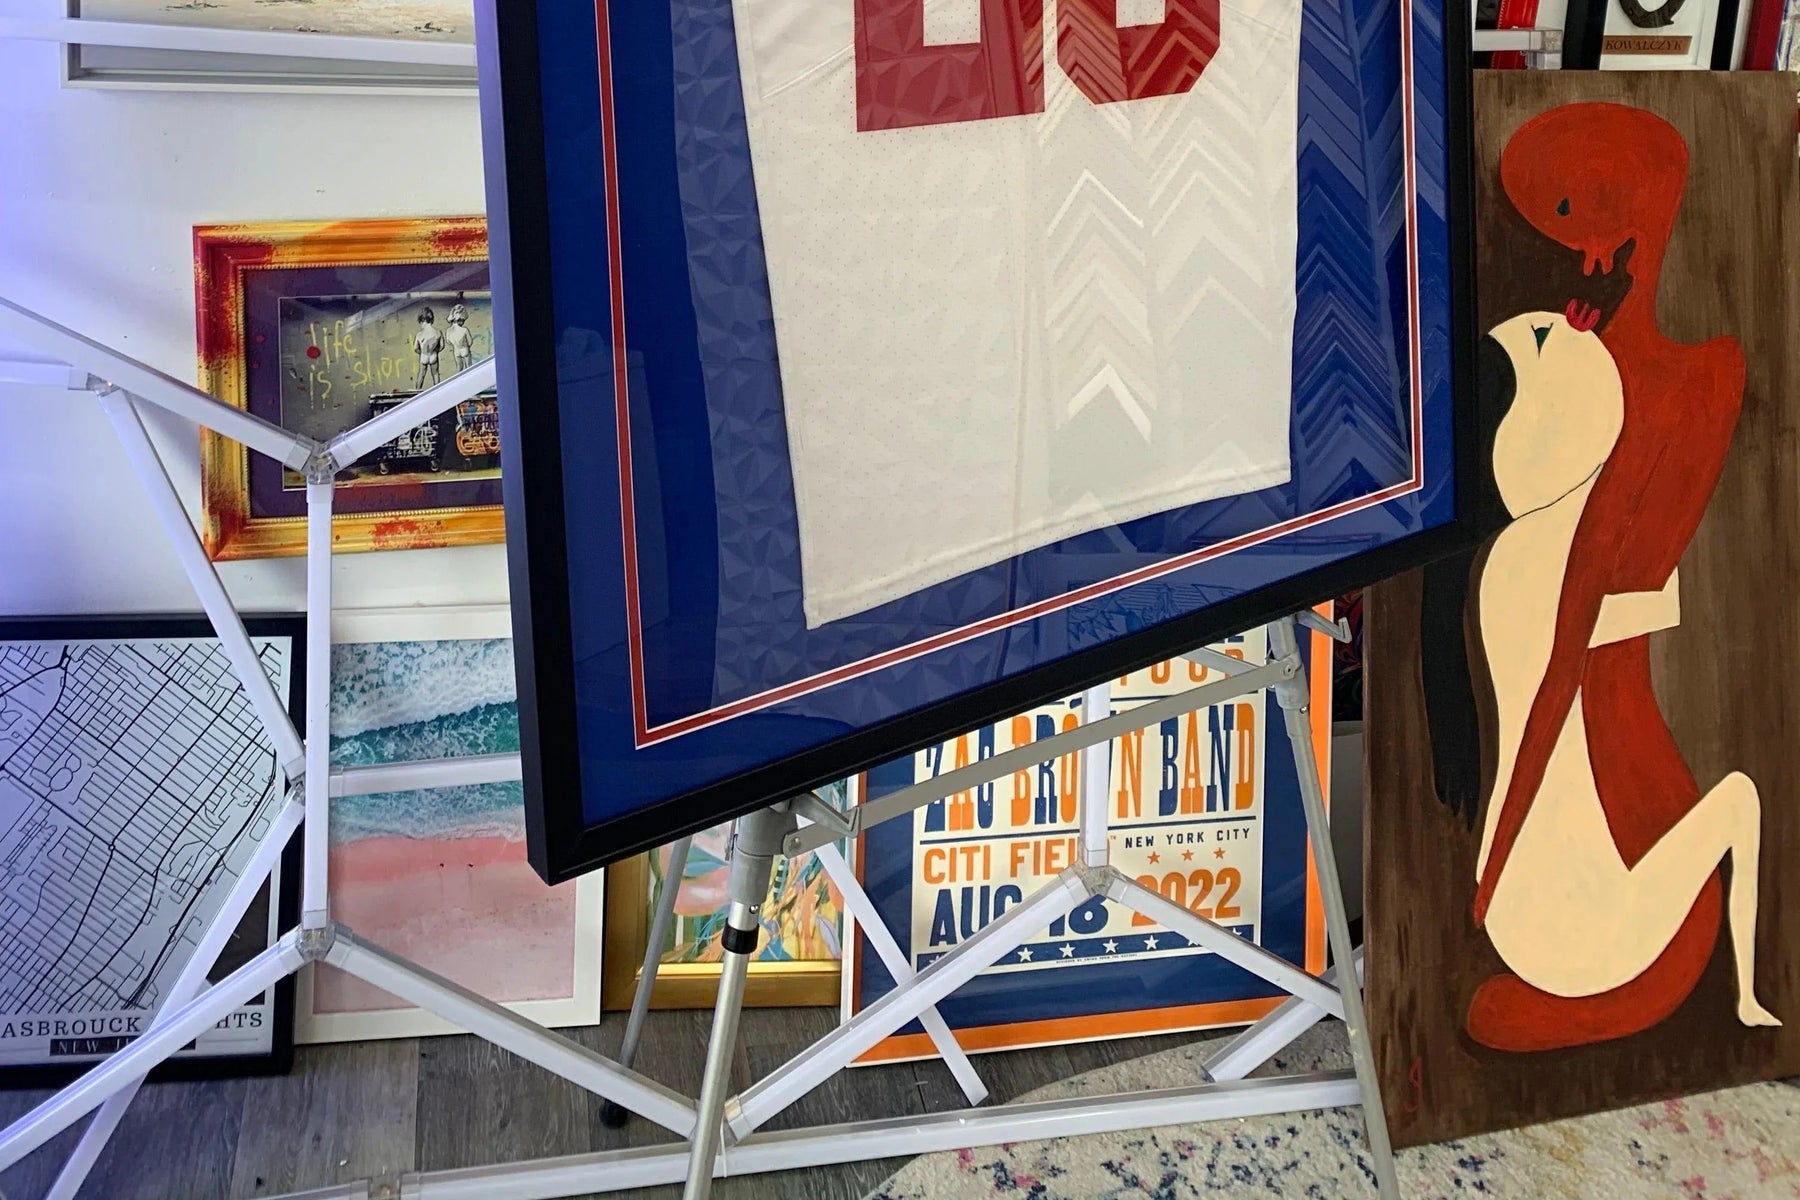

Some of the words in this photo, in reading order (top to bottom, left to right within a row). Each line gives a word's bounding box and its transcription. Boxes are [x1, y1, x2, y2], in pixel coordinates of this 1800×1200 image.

[309, 364, 332, 401] is
[923, 722, 996, 833] ZAC
[1011, 712, 1144, 828] BRON
[1158, 702, 1255, 818] BAND
[1125, 836, 1155, 849] NEW
[1166, 831, 1205, 845] YORK
[1216, 827, 1251, 842] CITY
[923, 844, 991, 885] CITI
[1010, 836, 1109, 879] FIEL
[1131, 866, 1242, 928] 2022
[1, 1016, 143, 1039] ASBROUCK
